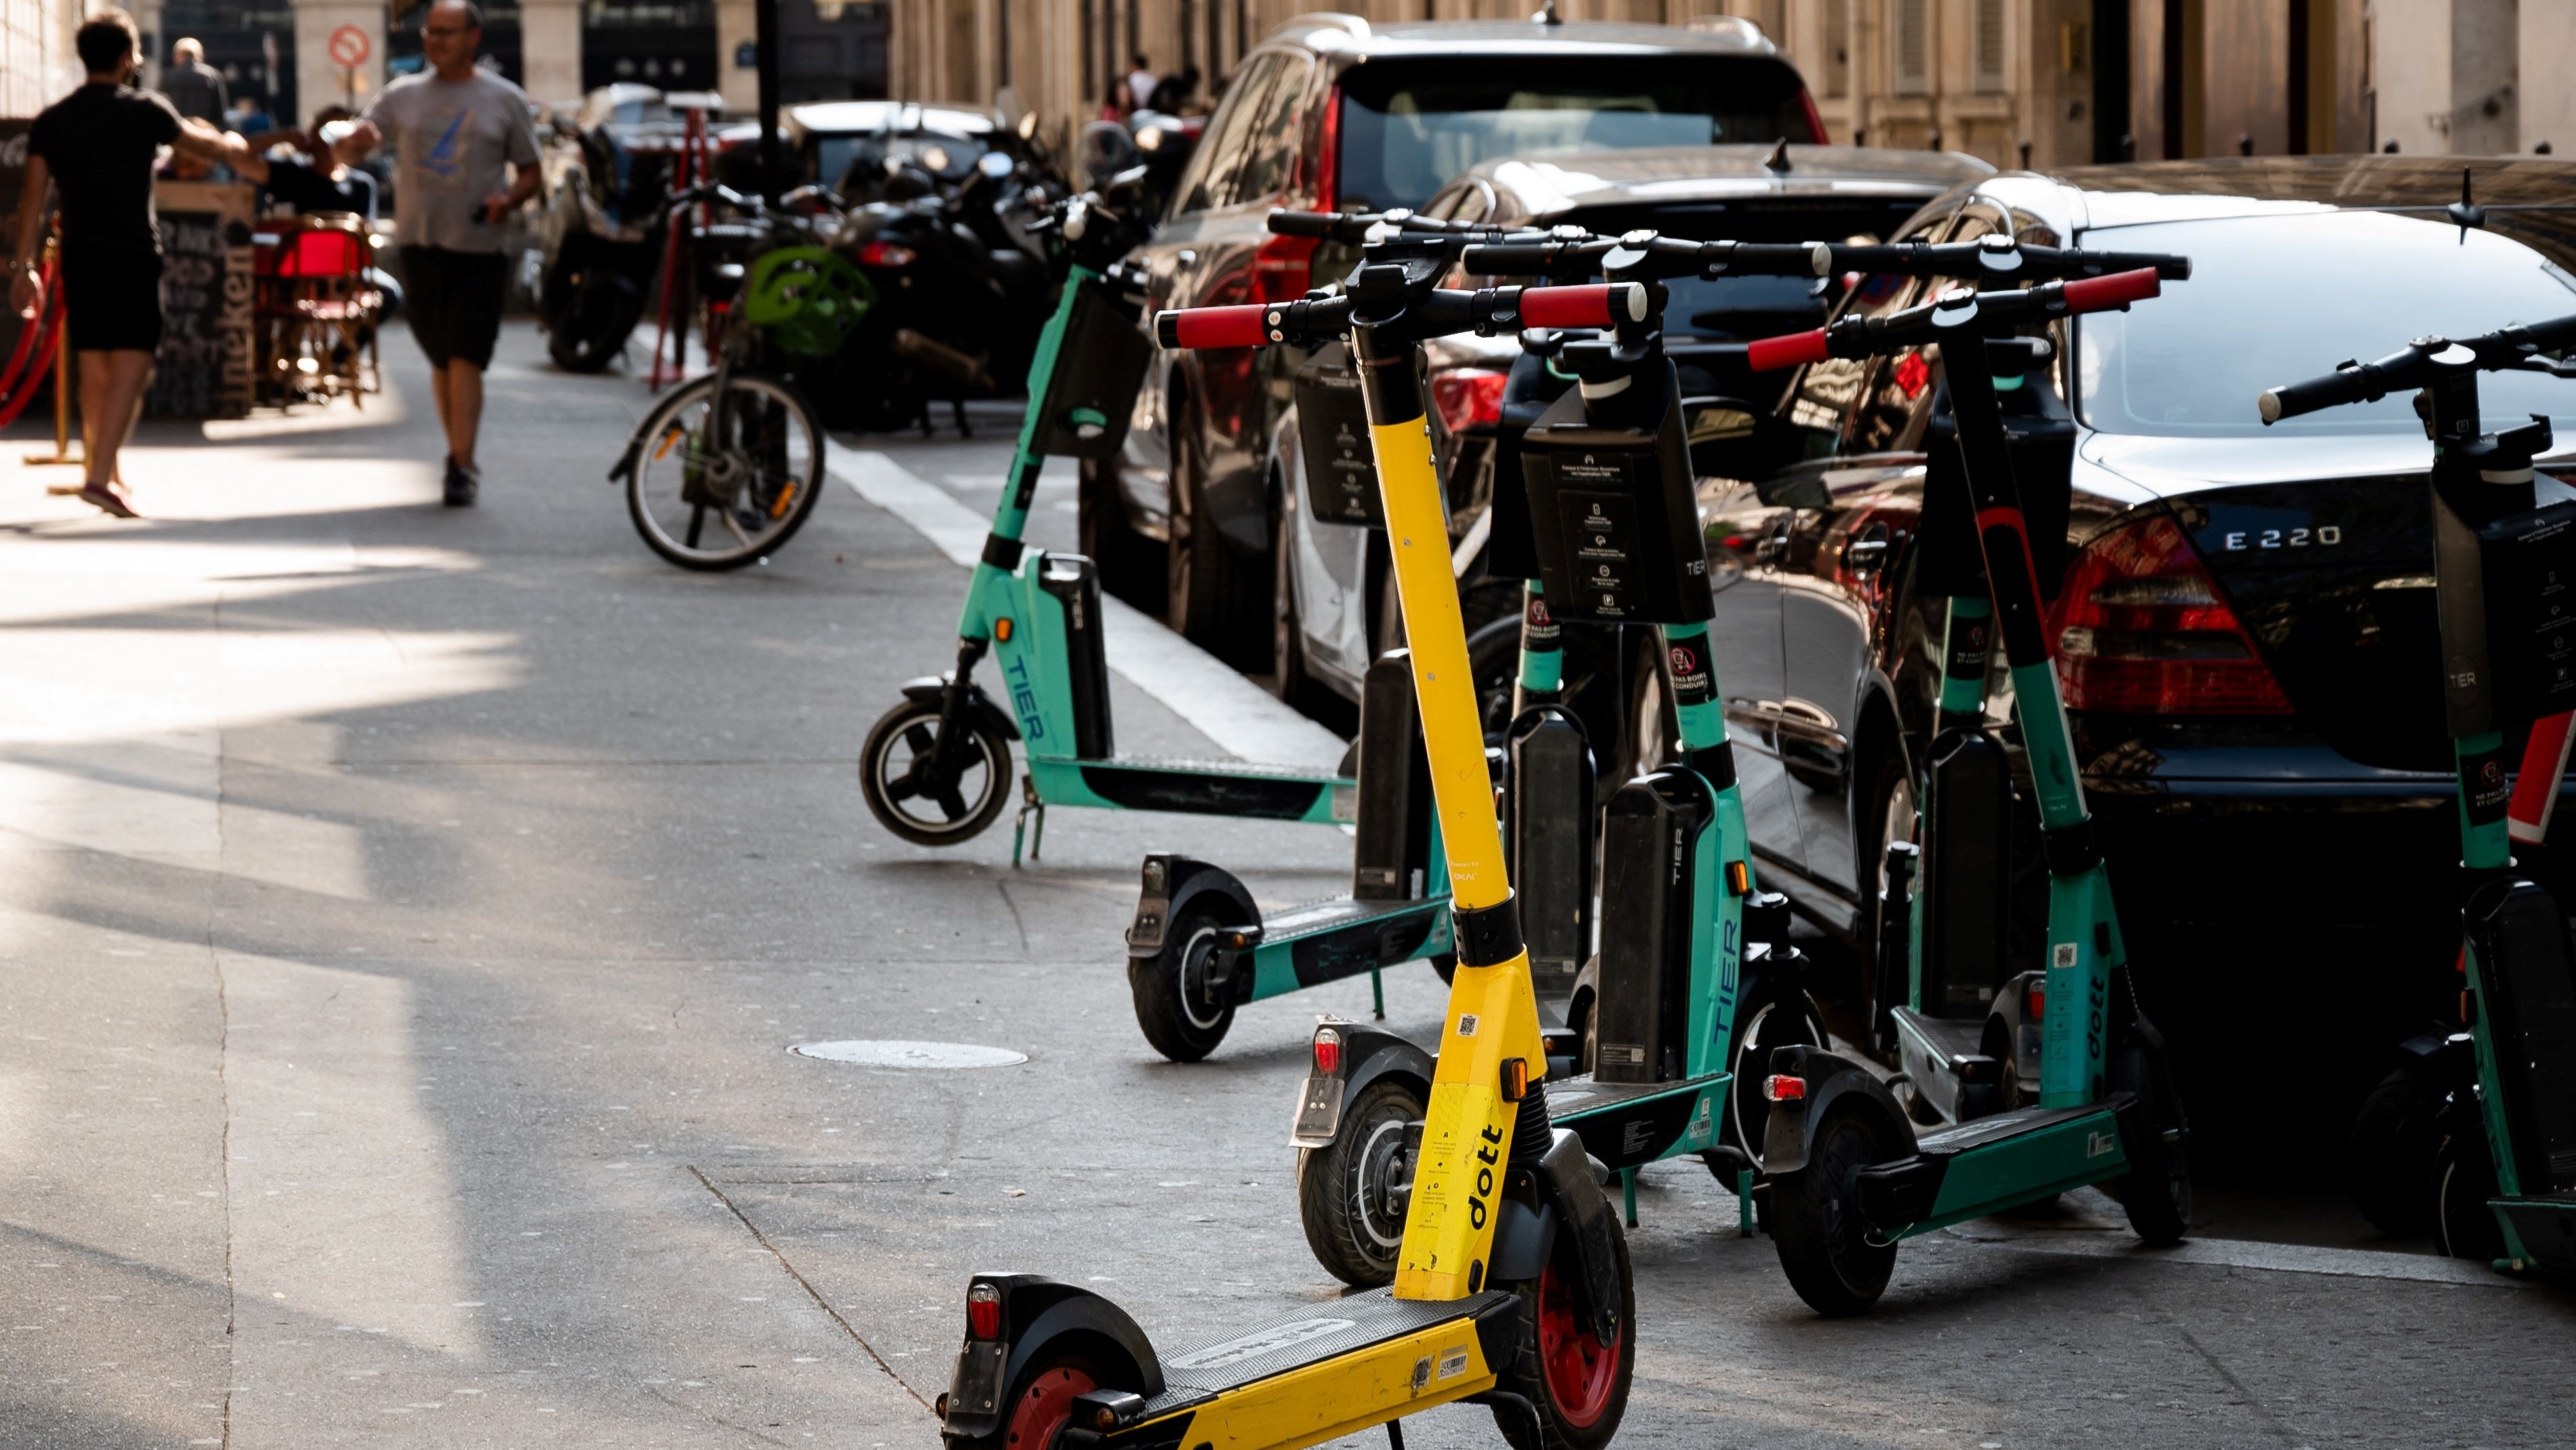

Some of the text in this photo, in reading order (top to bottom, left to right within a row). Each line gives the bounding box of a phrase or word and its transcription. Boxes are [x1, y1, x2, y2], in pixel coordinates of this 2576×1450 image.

[1686, 560, 1706, 575] TIER
[2225, 526, 2341, 550] E 220
[1009, 654, 1045, 742] TIER
[2450, 672, 2477, 688] TIER
[1673, 827, 1683, 885] TIER
[1713, 918, 1738, 1044] TIER
[2088, 975, 2105, 1060] dott
[1468, 1124, 1503, 1230] dott
